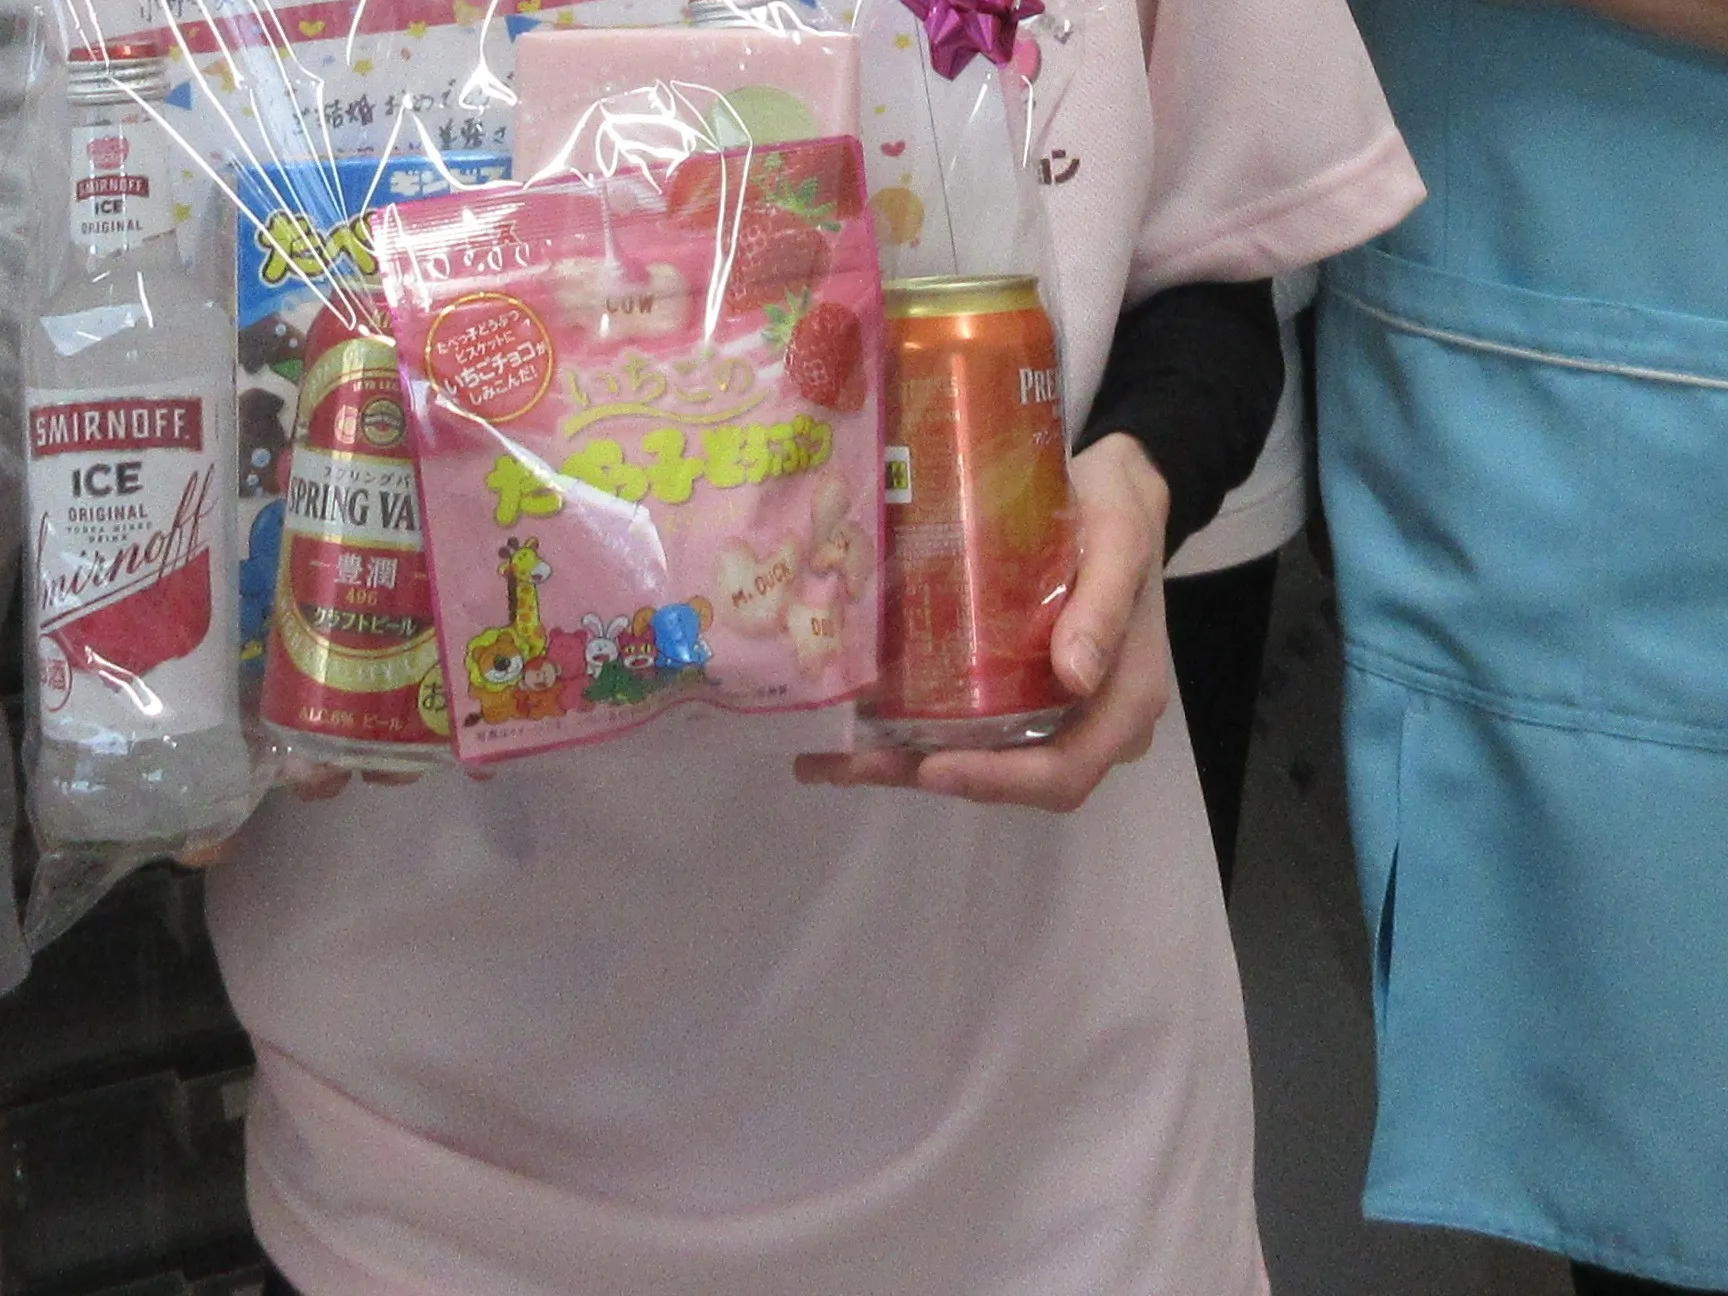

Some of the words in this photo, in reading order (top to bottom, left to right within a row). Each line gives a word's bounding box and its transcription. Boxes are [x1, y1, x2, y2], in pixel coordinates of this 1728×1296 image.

[94, 198, 124, 215] ICE
[80, 219, 144, 235] ORIGINAL
[35, 408, 188, 448] SMIRNOFF
[72, 461, 144, 498] ICE
[67, 502, 149, 522] ORIGINAL
[291, 476, 371, 527] SPRING
[313, 605, 417, 637] クラフトビール
